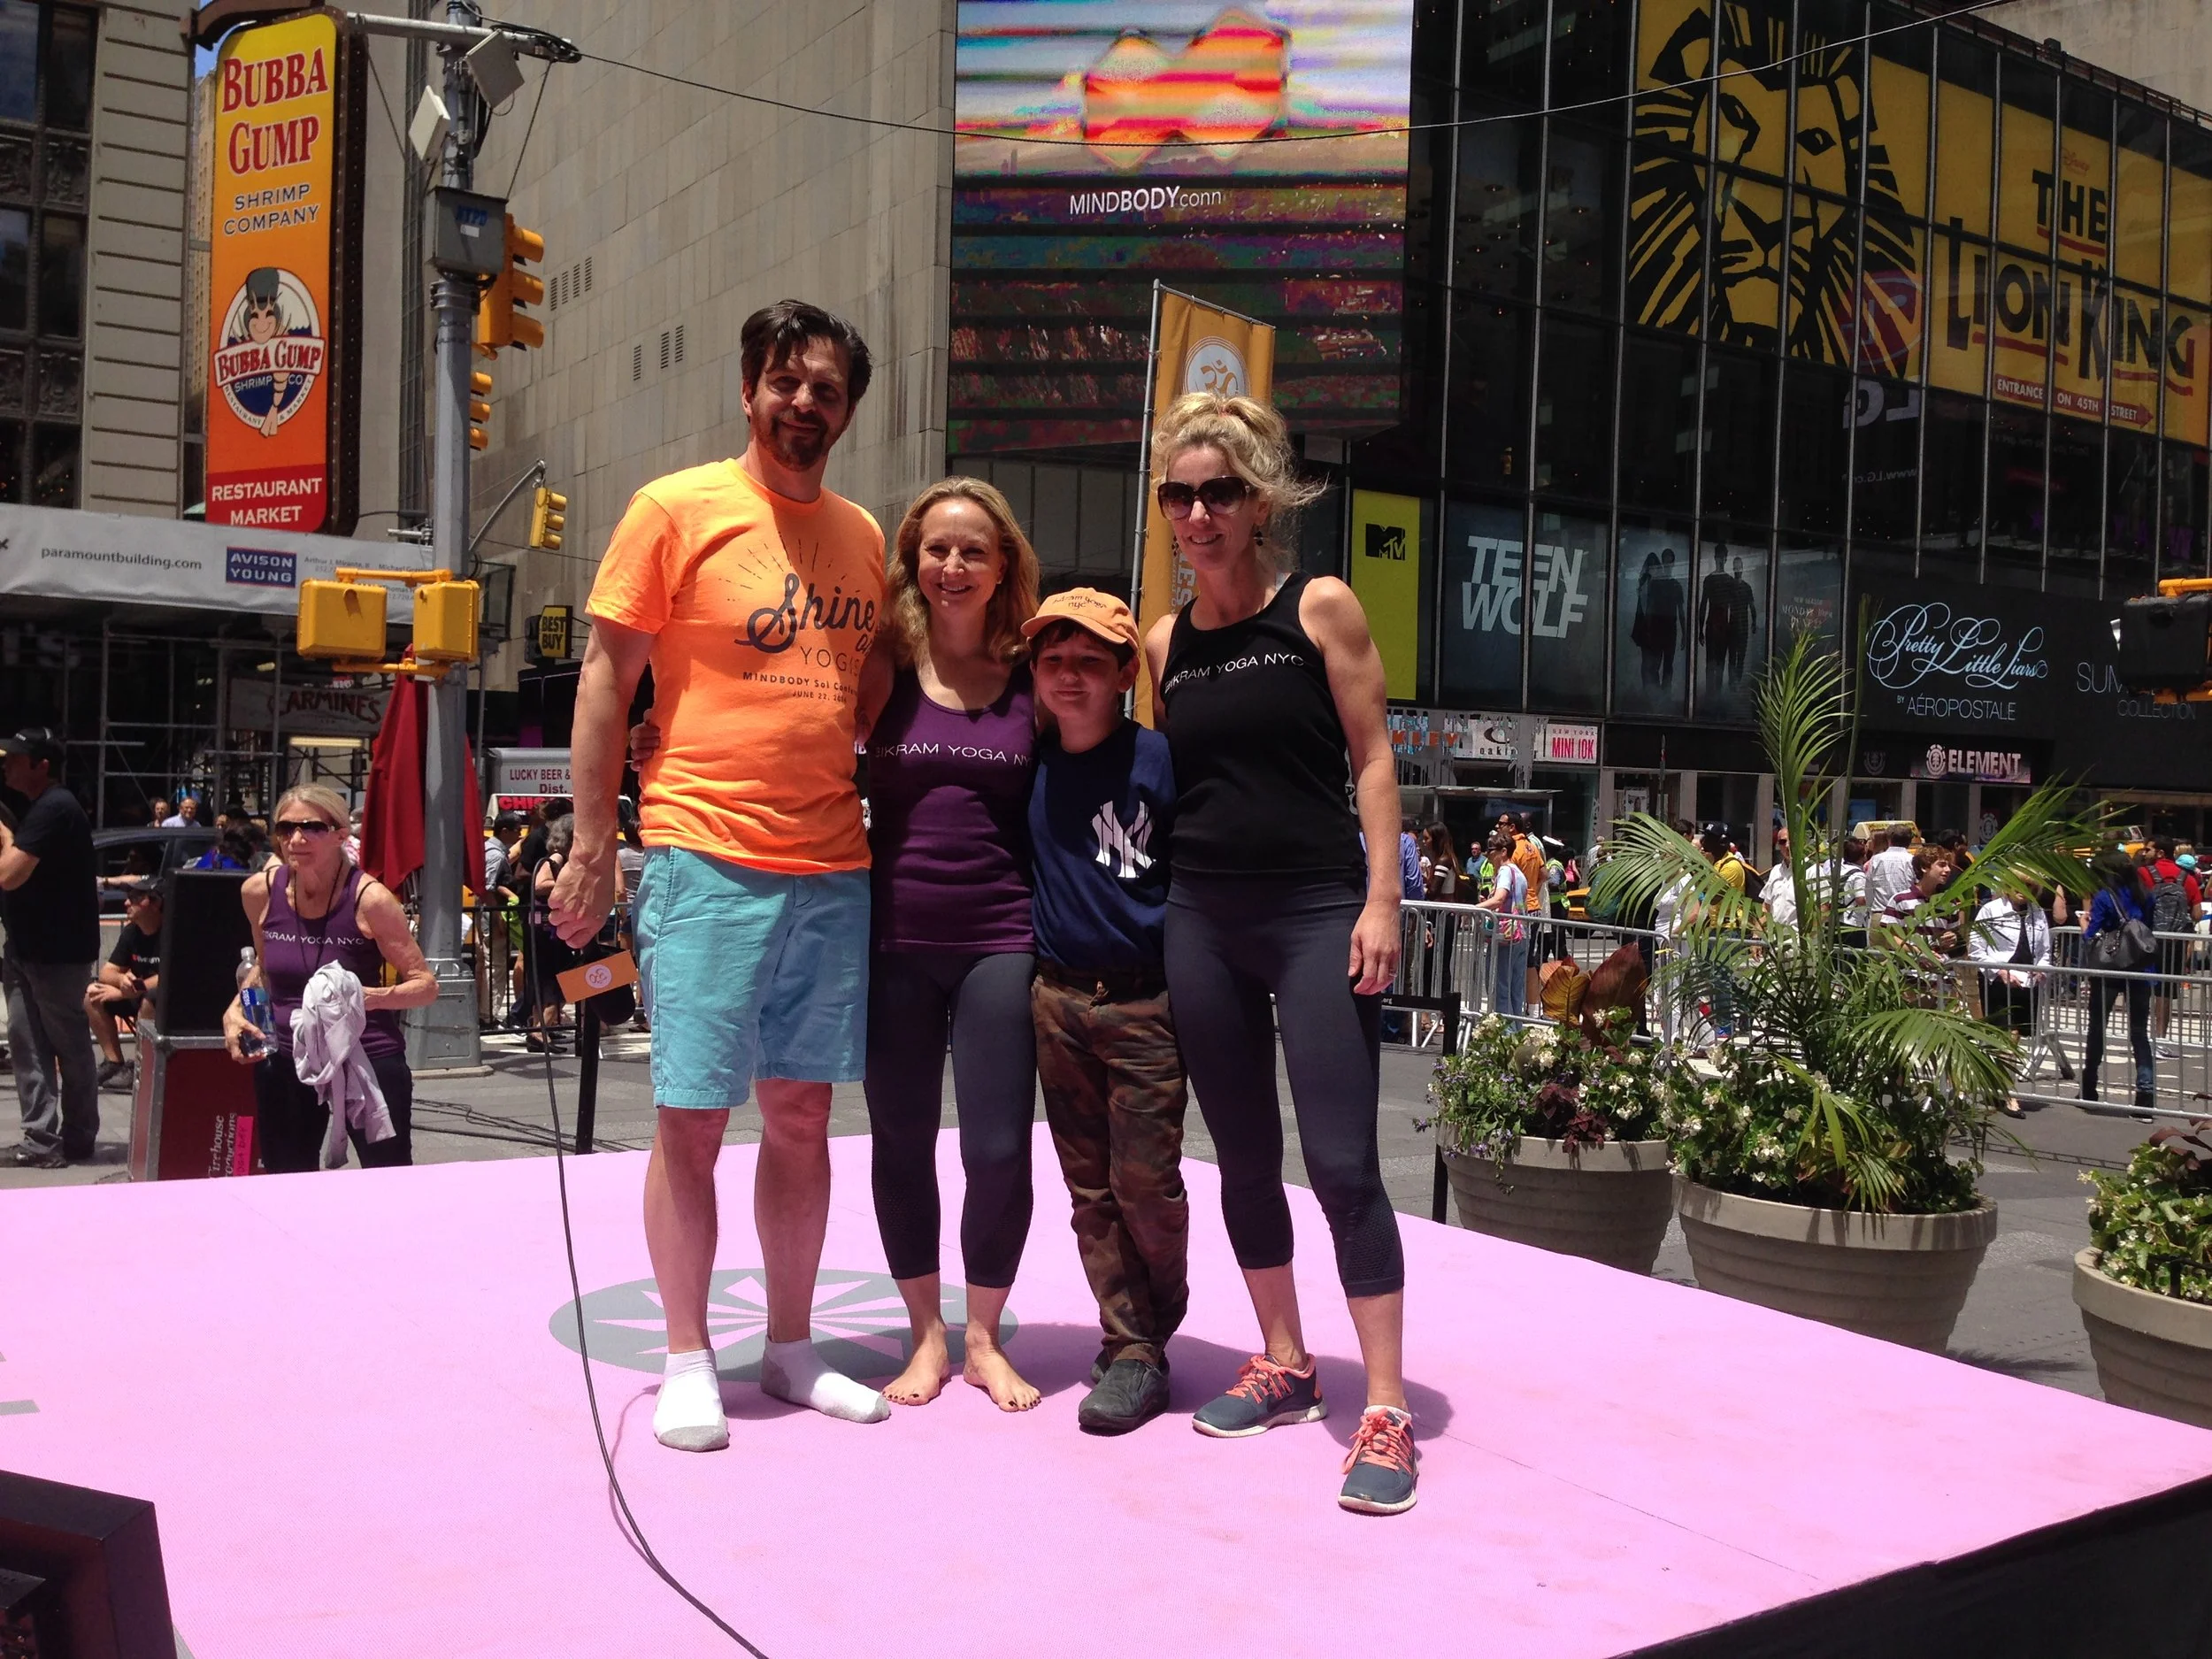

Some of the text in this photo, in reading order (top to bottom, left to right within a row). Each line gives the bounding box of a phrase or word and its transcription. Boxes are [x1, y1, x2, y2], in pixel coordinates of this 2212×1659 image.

[221, 48, 328, 112] BUBBA
[228, 116, 320, 175] GUMP
[234, 184, 311, 211] SHRIMP
[2032, 169, 2106, 243] THE
[224, 204, 319, 235] COMPANY
[1947, 217, 2195, 380] LION KING
[218, 340, 321, 380] BUBBA GUMP
[234, 375, 273, 393] SHRIMP
[225, 385, 262, 425] RESTAURANT
[1996, 378, 2139, 420] ENTRANCE ON 45TH STREET
[211, 478, 323, 502] RESTAURANT
[230, 505, 303, 526] MARKET
[41, 547, 203, 571] paramountbuilding.com
[229, 552, 293, 568] AVISON
[1467, 535, 1584, 594] TEEN
[230, 567, 292, 583] YOUNG
[733, 572, 876, 654] Shine
[1463, 581, 1589, 639] WOLF
[541, 616, 565, 632] BEST
[541, 633, 564, 650] BUY
[1216, 656, 1259, 674] YOGA
[1264, 652, 1304, 666] NYC
[743, 672, 810, 687] MINDBODY
[1897, 692, 2017, 721] BY AÉROPOSTALE
[2116, 698, 2196, 720] COLLECTION
[948, 745, 1008, 763] YOGA
[1013, 754, 1034, 767] NY
[1552, 736, 1594, 760] MINI 10K
[510, 768, 571, 780] LUCKY BEER &
[1947, 749, 2022, 776] ELEMENT
[540, 783, 567, 794] Dist.
